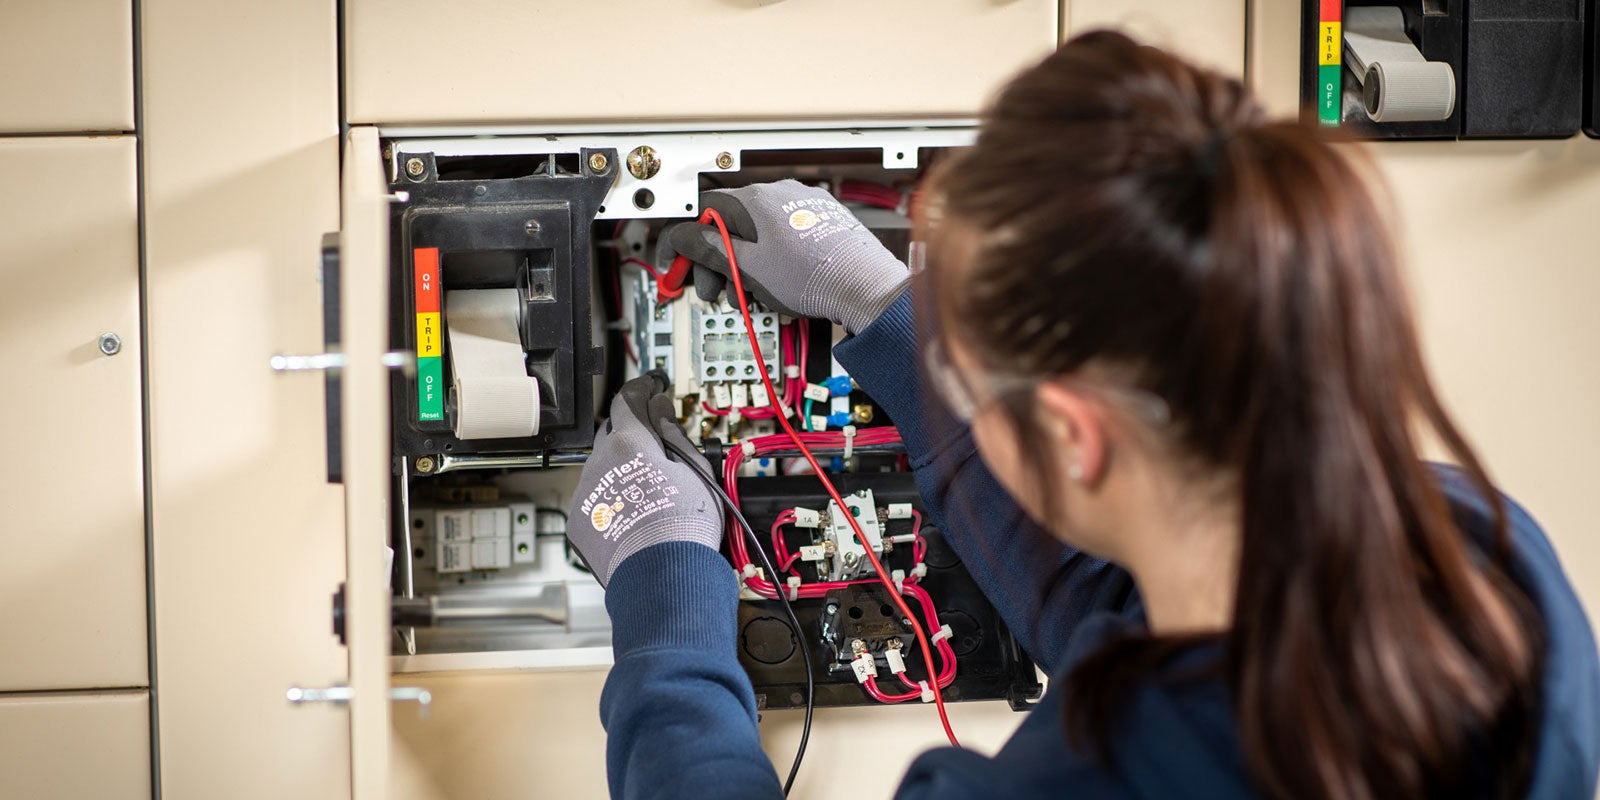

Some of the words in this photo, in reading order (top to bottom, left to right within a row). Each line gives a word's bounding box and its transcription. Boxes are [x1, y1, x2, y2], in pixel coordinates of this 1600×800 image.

[422, 273, 431, 290] ON
[425, 376, 433, 402] OFF
[581, 456, 644, 515] MaxiFlex
[619, 466, 650, 484] Ultimate
